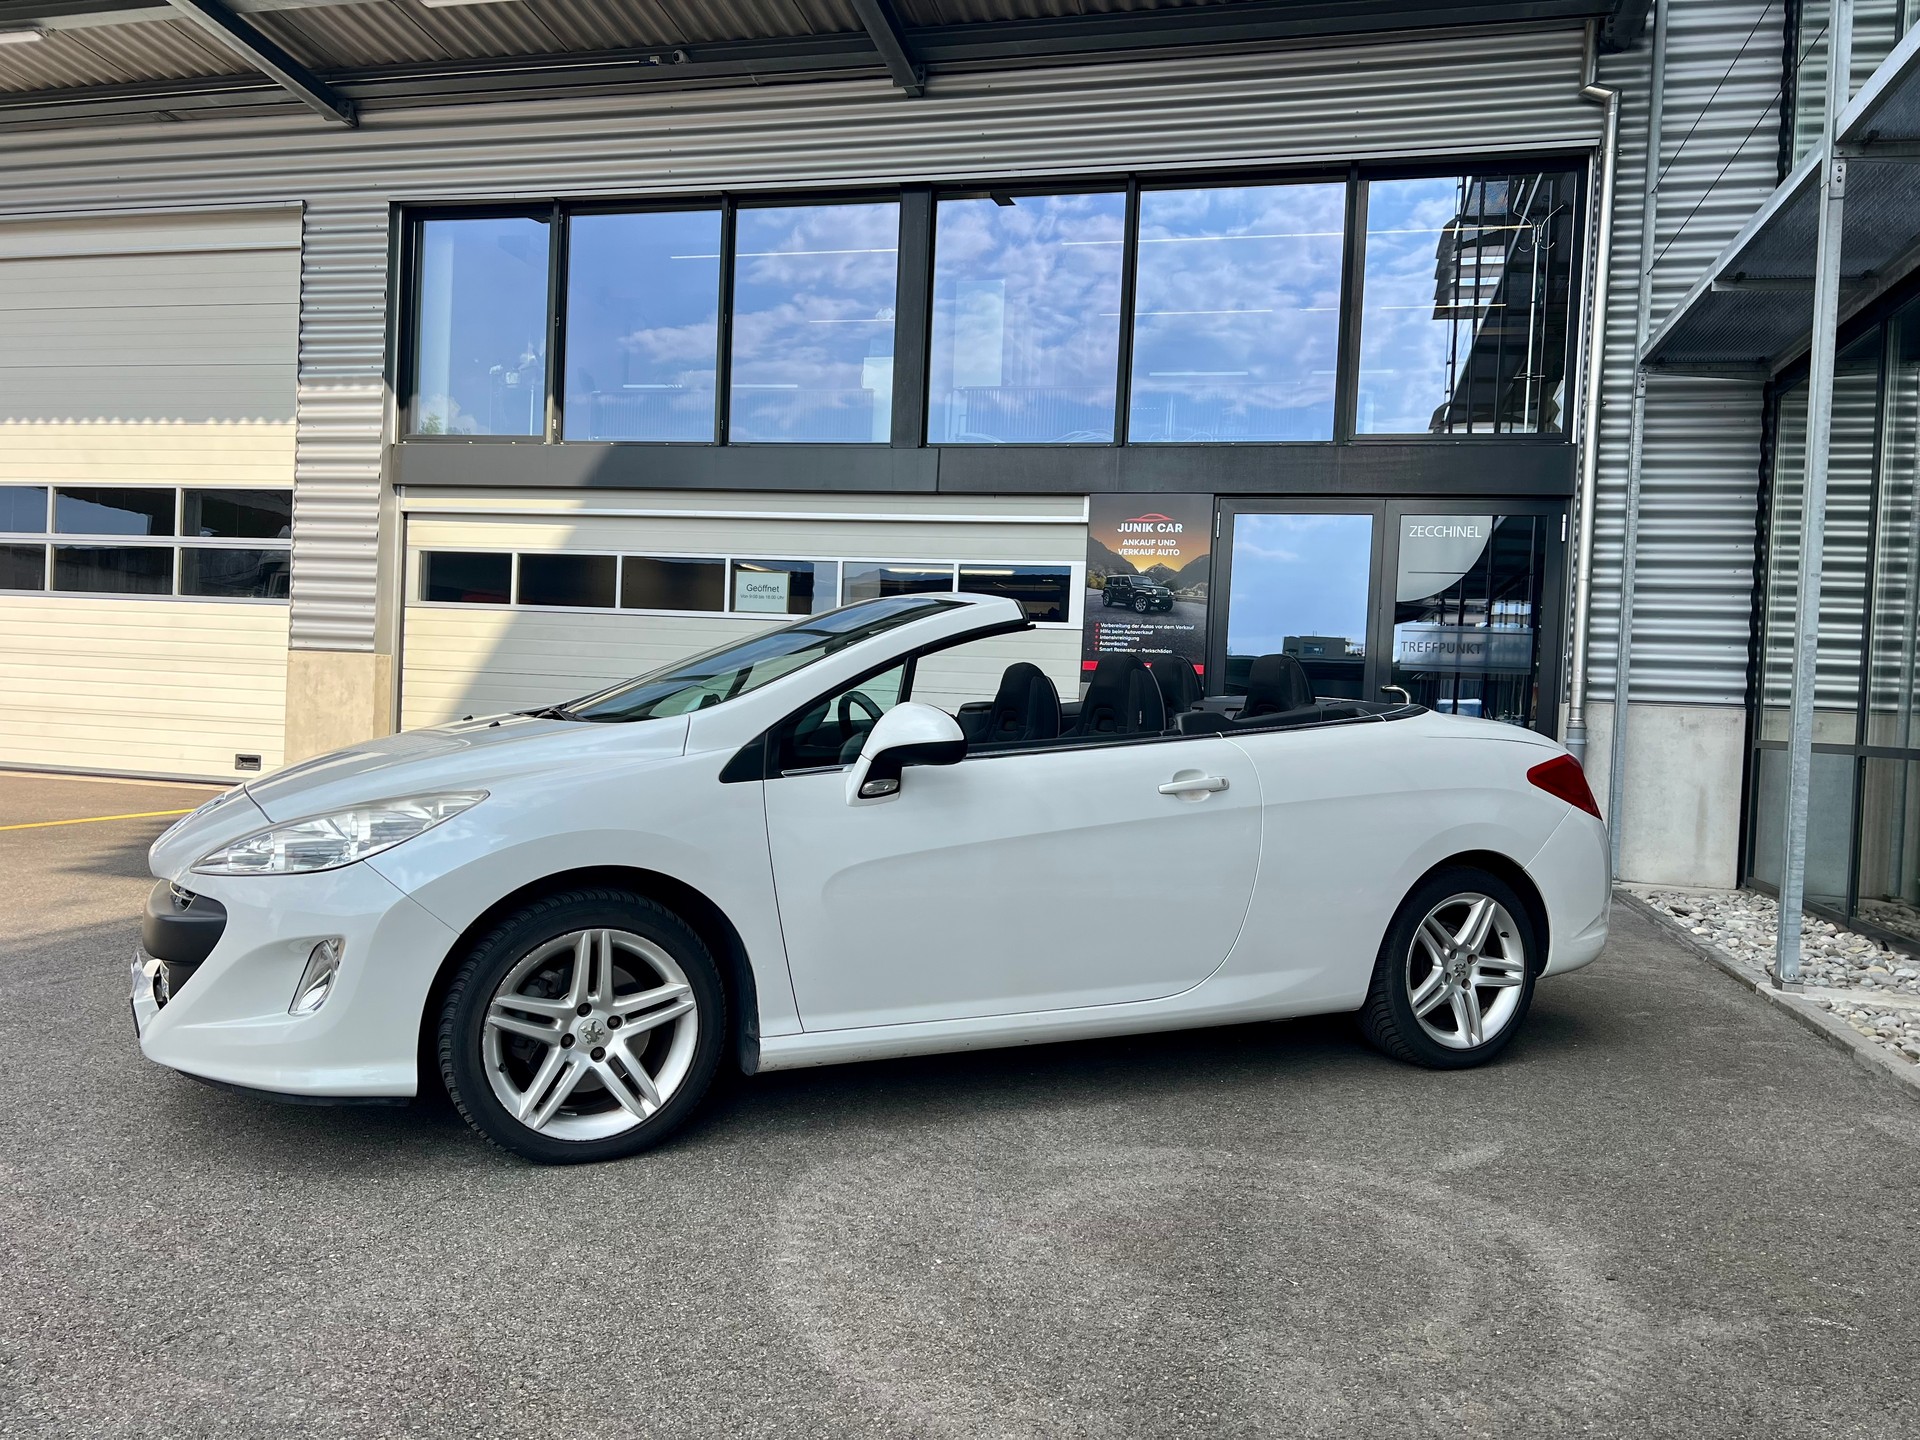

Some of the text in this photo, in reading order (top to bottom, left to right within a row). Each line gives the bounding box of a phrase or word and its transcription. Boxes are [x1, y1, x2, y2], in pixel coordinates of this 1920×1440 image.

[1117, 523, 1183, 533] JUNIK CAR
[1409, 525, 1482, 538] ZECCHINEL
[1117, 548, 1180, 556] VERKAUF AUTO
[746, 583, 780, 593] Geöffnet
[1401, 641, 1483, 655] TREFFPUNKT
